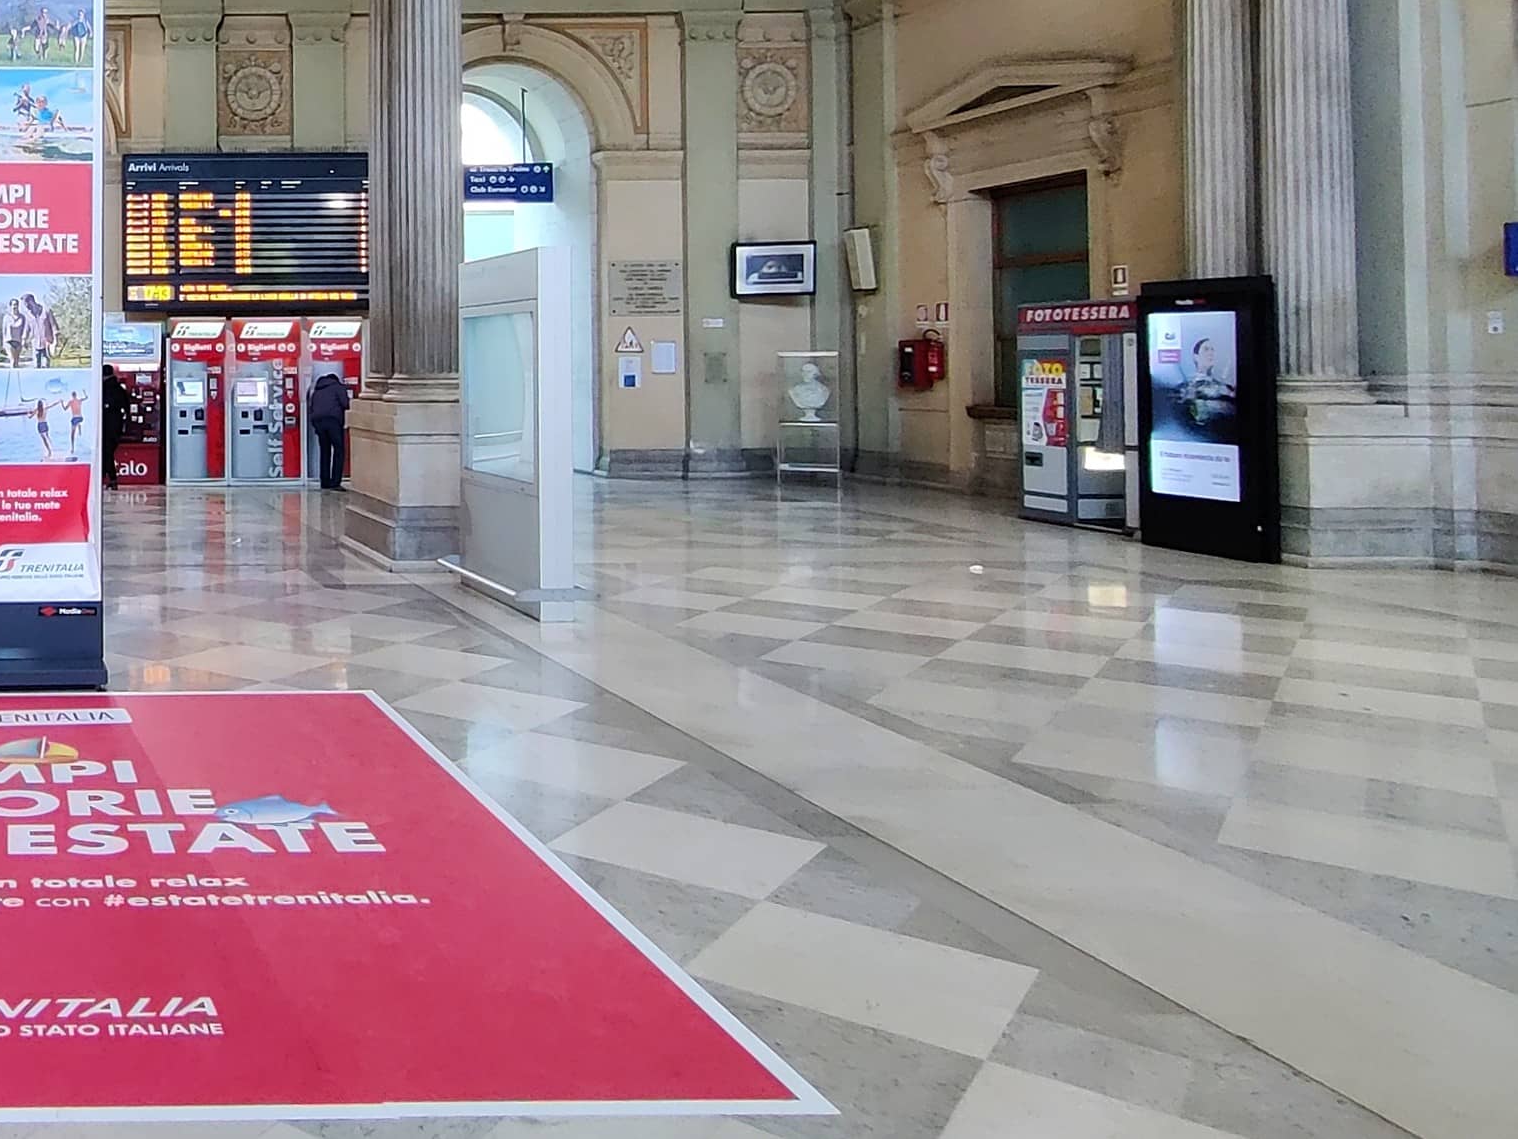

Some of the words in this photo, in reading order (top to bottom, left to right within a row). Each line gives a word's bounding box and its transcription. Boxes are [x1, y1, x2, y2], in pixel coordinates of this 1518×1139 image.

[128, 162, 157, 172] Arrivi
[1025, 305, 1130, 322] FOTOTESSERA
[1025, 376, 1063, 385] TESSERA
[268, 358, 283, 433] Service
[268, 439, 283, 478] Self
[114, 460, 148, 477] talo
[7, 488, 37, 498] totale
[40, 487, 68, 498] relax
[1, 500, 12, 510] le
[14, 501, 32, 510] tue
[34, 501, 60, 510] mete
[20, 564, 84, 572] TRENITALIA
[7, 821, 387, 855] ESTATE
[31, 875, 138, 889] totale
[150, 874, 250, 888] relax
[36, 897, 90, 908] con
[103, 890, 432, 907] #estatetrenitalia.
[19, 1024, 100, 1037] STATO
[108, 1023, 225, 1036] ITALIANE
